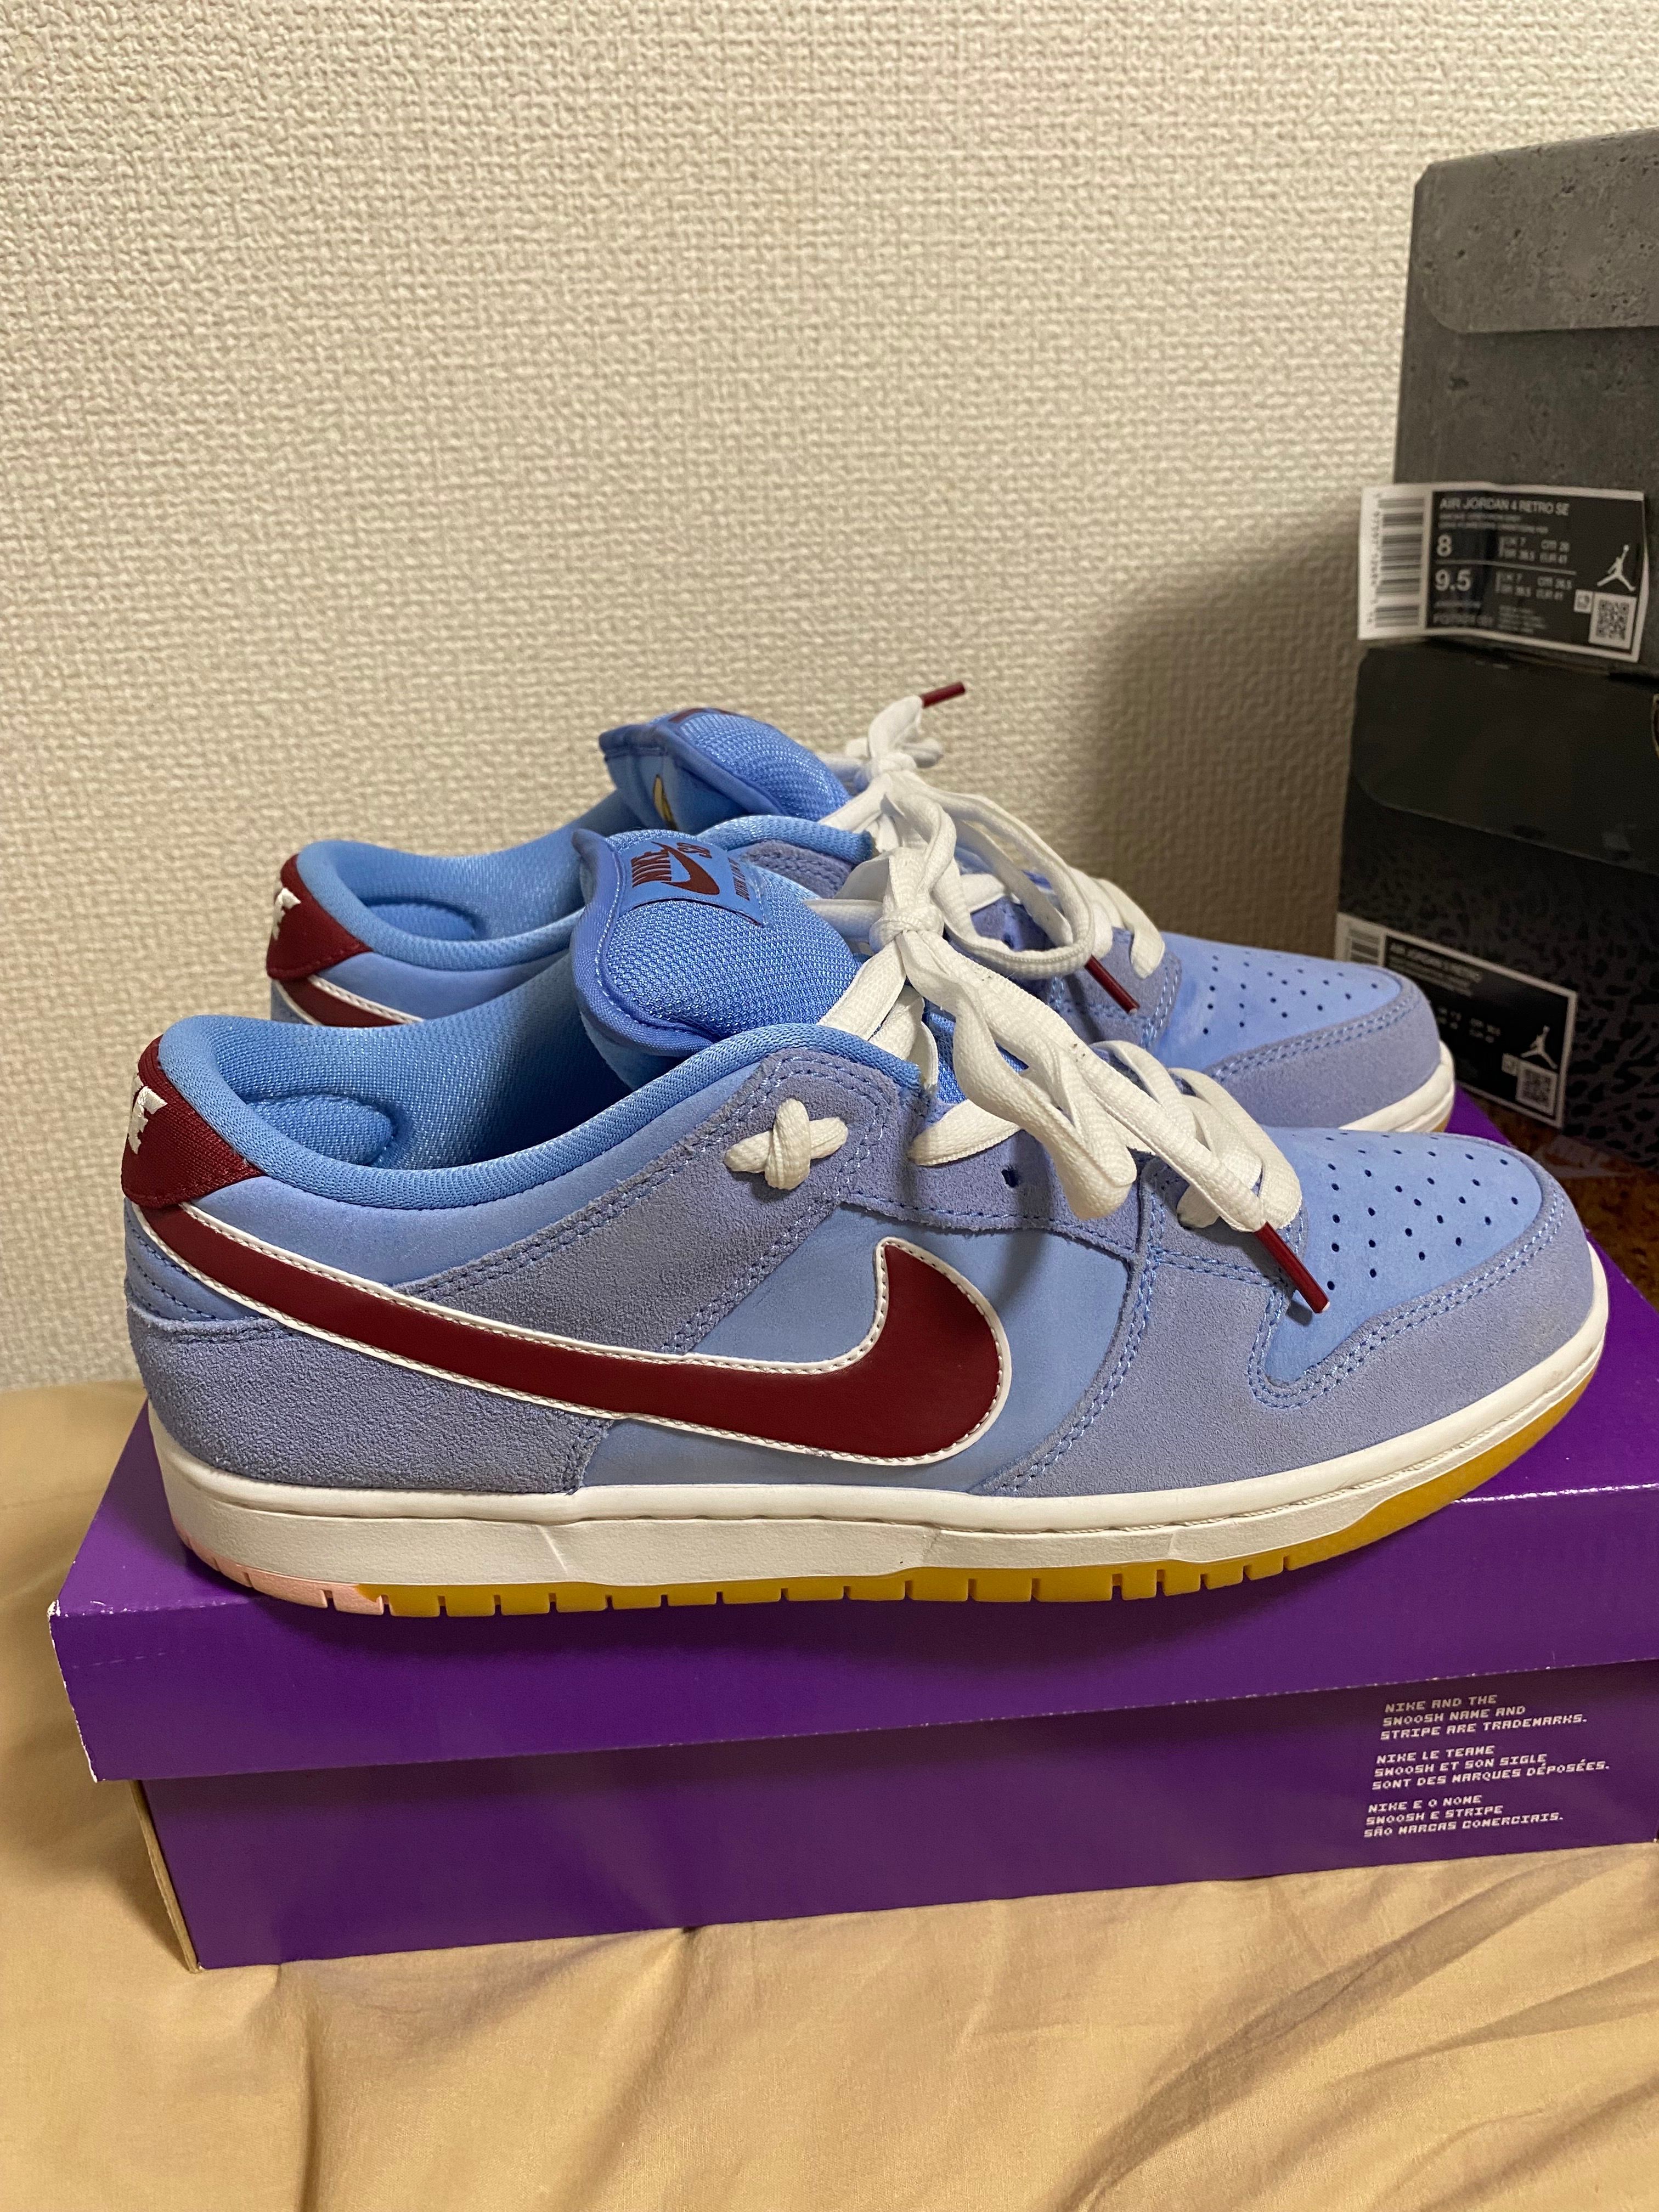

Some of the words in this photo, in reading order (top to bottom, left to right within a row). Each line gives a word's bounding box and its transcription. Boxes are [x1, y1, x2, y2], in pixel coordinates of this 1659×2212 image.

[1440, 497, 1462, 510] AIR
[1463, 496, 1510, 511] JORDAN
[1519, 500, 1554, 515] RETRO
[1436, 534, 1452, 557] 8
[1435, 568, 1472, 592] 9.5
[1385, 1701, 1426, 1713] NIKE
[1431, 1697, 1463, 1709] AND
[1468, 1694, 1498, 1706] THE
[1449, 1708, 1490, 1721] NAME
[1495, 1705, 1526, 1717] AND
[1380, 1726, 1441, 1740] STRIPE
[1446, 1723, 1477, 1735] ARE
[1483, 1713, 1588, 1731] TRADEMARKS.
[1376, 1752, 1417, 1764] NIKE
[1422, 1750, 1440, 1760] LE
[1440, 1761, 1459, 1772] ET
[1464, 1758, 1495, 1769] SON
[1499, 1753, 1548, 1766] SIGLE
[1372, 1778, 1412, 1791] SONT
[1417, 1775, 1446, 1786] DES
[1452, 1768, 1521, 1784] MARQUES
[1368, 1801, 1408, 1814] NIKE
[1413, 1799, 1423, 1809] E
[1427, 1798, 1438, 1808] O
[1442, 1795, 1482, 1807] NOME
[1430, 1810, 1440, 1820] E
[1445, 1805, 1504, 1818] STRIPE
